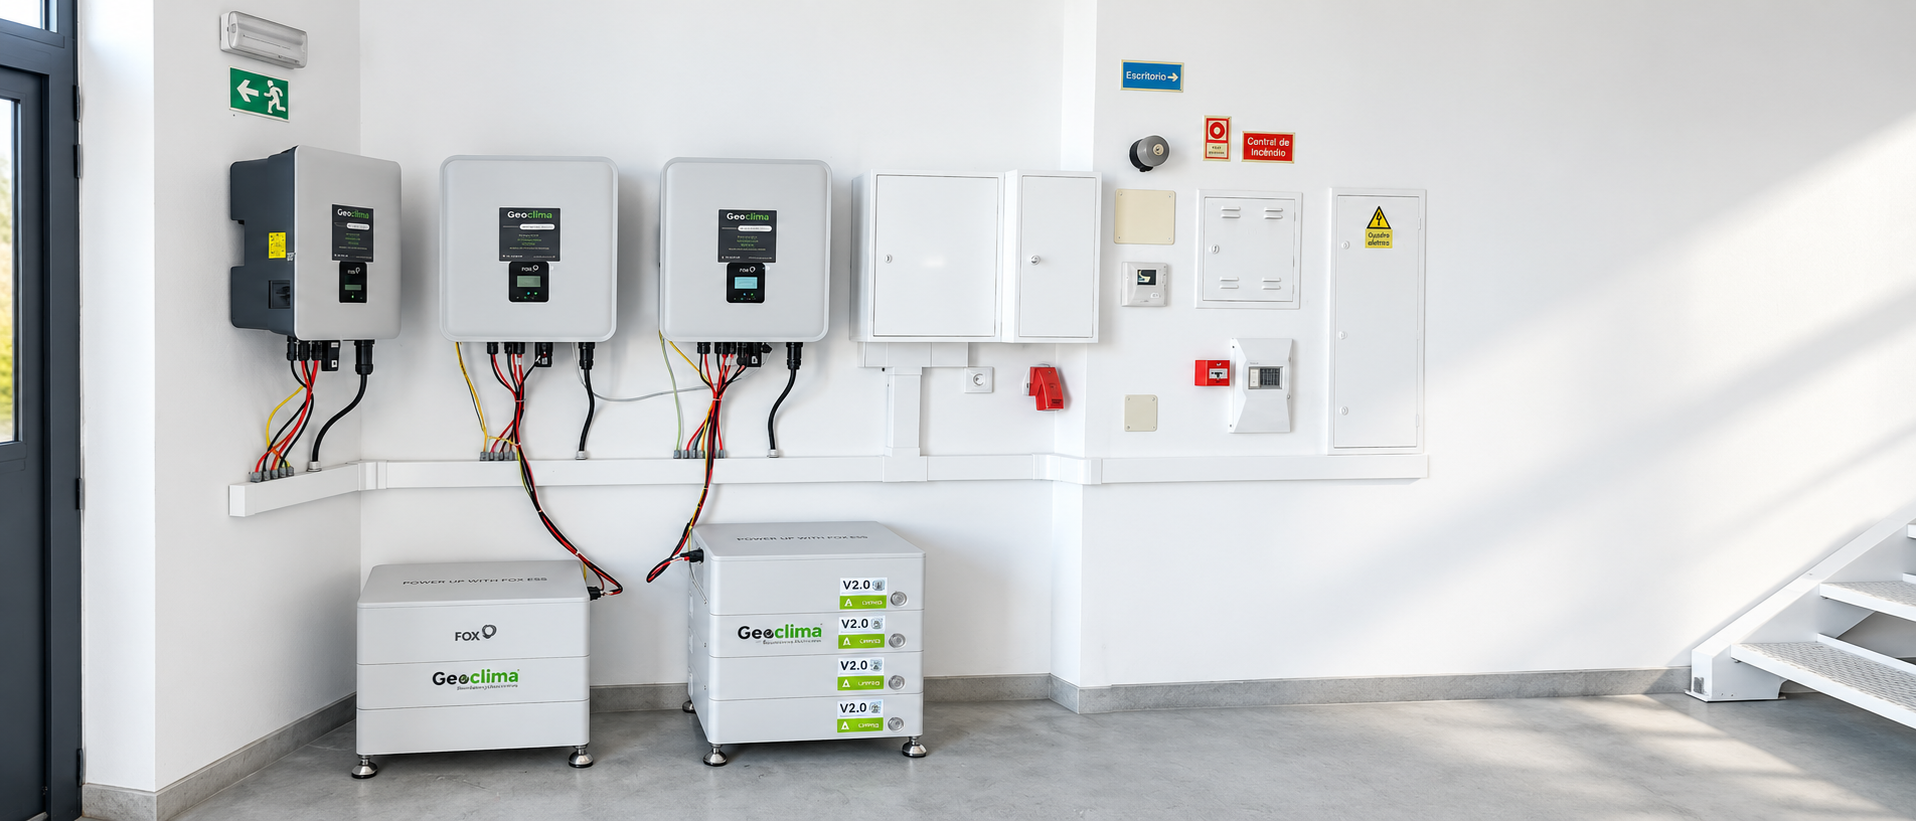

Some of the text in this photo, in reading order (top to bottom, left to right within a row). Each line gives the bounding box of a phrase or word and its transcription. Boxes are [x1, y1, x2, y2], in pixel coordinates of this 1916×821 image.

[507, 210, 552, 219] Geoclima
[843, 580, 871, 590] V2.0
[841, 618, 869, 629] V2.0
[454, 631, 481, 641] FOX
[737, 624, 822, 640] Geoclima
[840, 660, 868, 671] V2.0
[432, 669, 519, 686] Geoclima
[839, 702, 867, 713] V2.0
